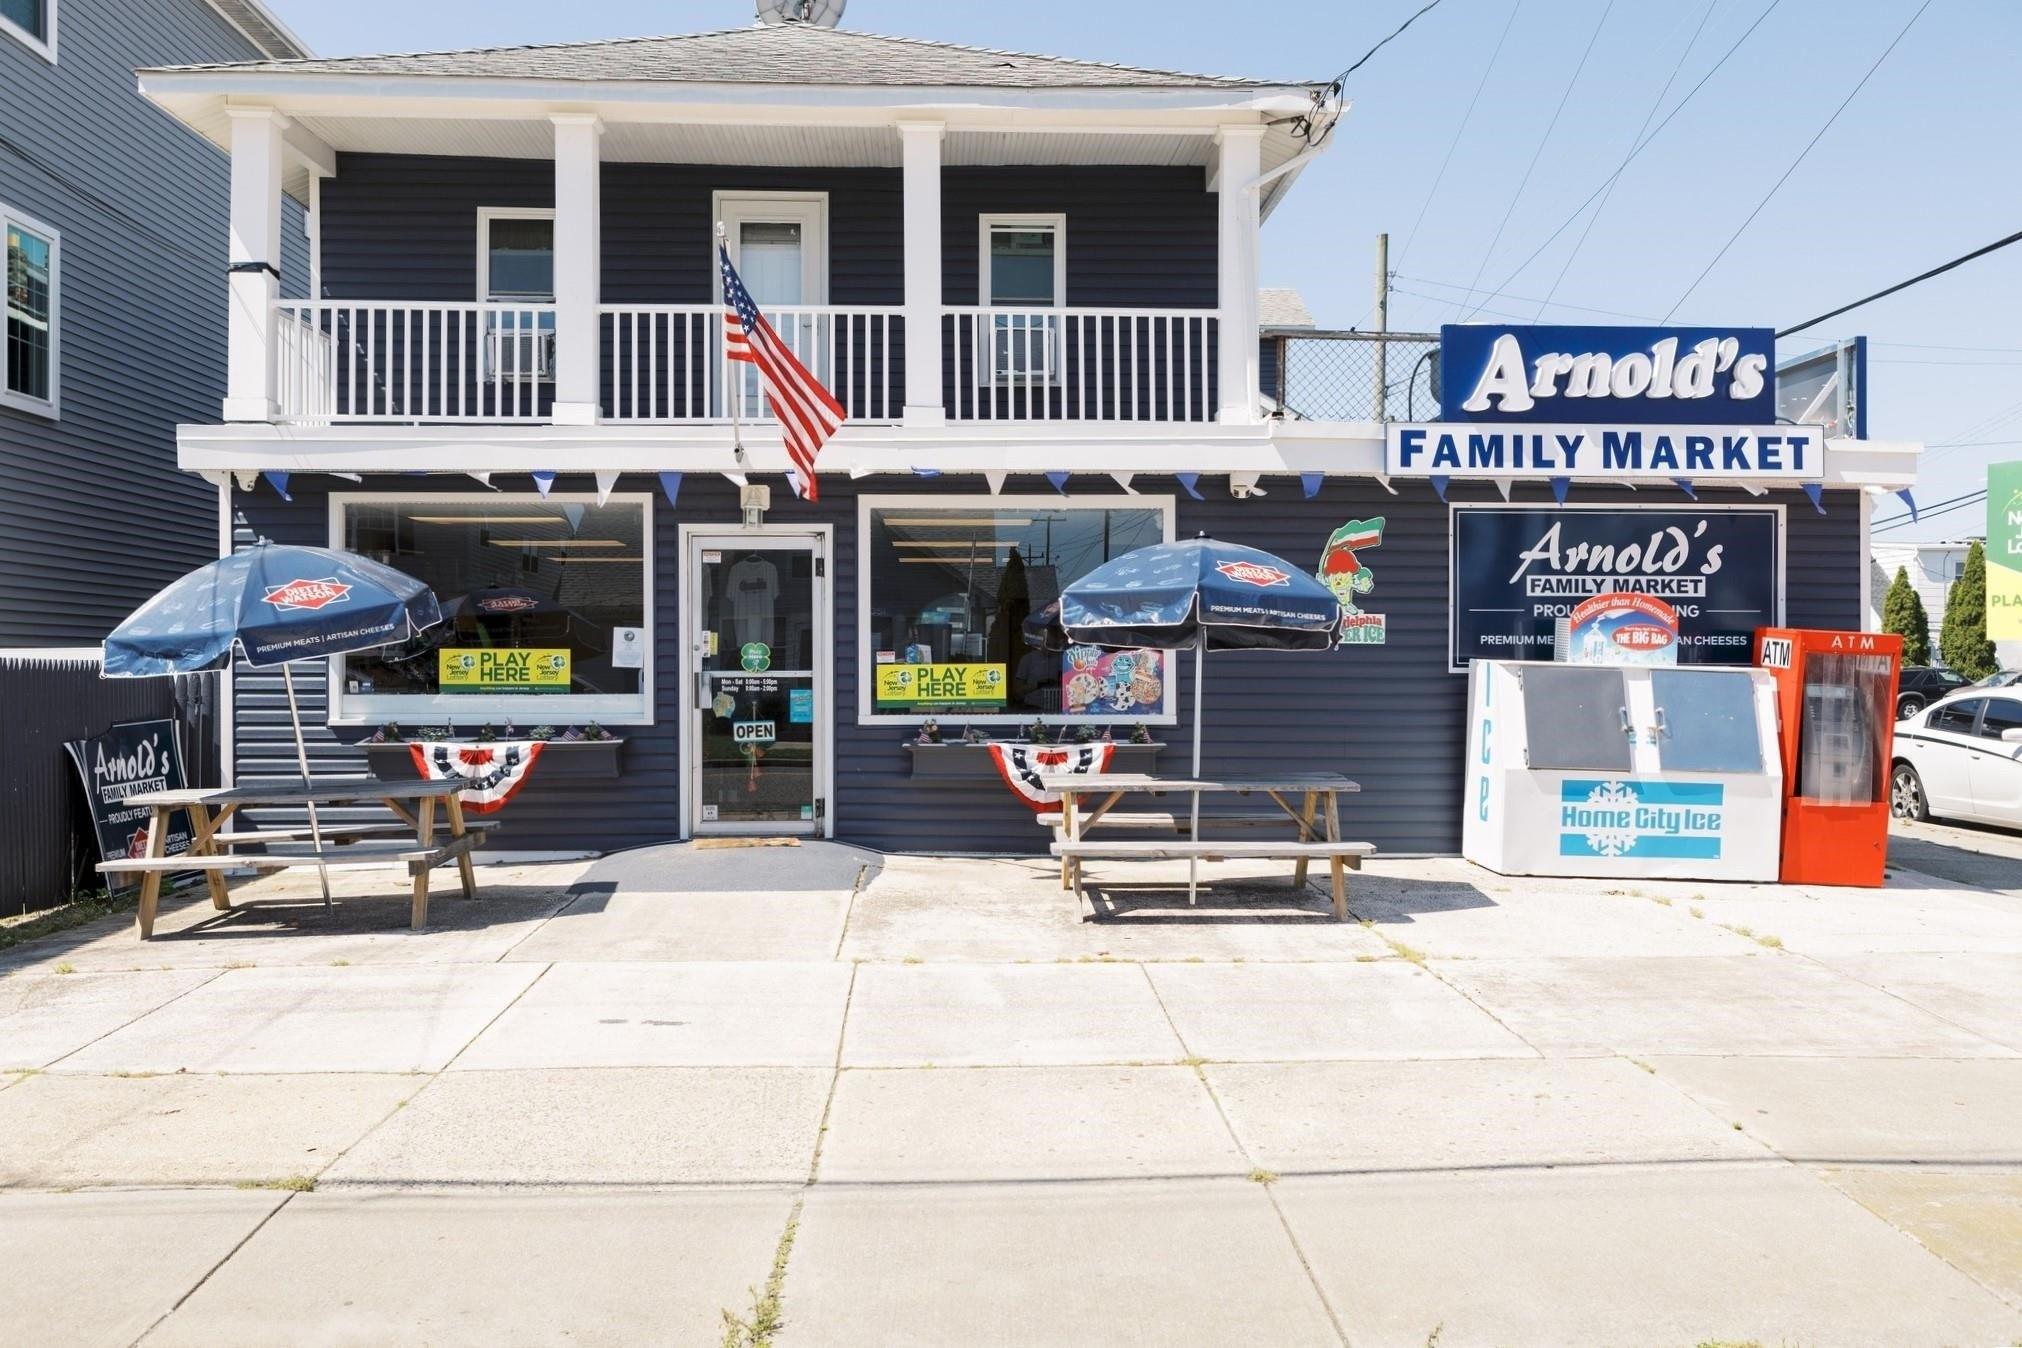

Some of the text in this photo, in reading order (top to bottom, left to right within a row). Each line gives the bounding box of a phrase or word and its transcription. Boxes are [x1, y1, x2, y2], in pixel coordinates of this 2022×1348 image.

[1462, 333, 1767, 413] Arnold's
[1400, 429, 1810, 470] FAMILY MARKET
[1509, 519, 1723, 585] Arnold's
[284, 584, 319, 596] DIETZ
[1530, 578, 1703, 595] FAMILY MARKET
[279, 588, 336, 604] WATSON
[1991, 594, 2022, 607] PLA
[1210, 605, 1326, 621] PREMIUM MEATS ARTISAN CHEESES
[1533, 604, 1574, 617] PROU
[1573, 599, 1609, 624] Healthier
[1611, 597, 1630, 607] than
[1632, 597, 1675, 625] Homemade
[1343, 615, 1382, 628] delphia
[256, 623, 395, 654] PREMIUM MEATS ARTISAN CHEESES
[1364, 625, 1384, 643] ICE
[1480, 635, 1534, 645] PREMIUM
[1694, 635, 1747, 646] CHEESES
[1615, 632, 1631, 645] THE
[1632, 631, 1650, 645] BIG
[1651, 633, 1667, 645] BAG
[1831, 635, 1874, 650] ATM
[480, 652, 531, 667] PLAY
[1762, 640, 1791, 667] ATM
[449, 669, 469, 677] Jersey
[480, 667, 530, 682] HERE
[540, 669, 559, 677] Jersey
[917, 667, 967, 682] PLAY
[917, 682, 966, 697] HERE
[736, 724, 773, 739] OPEN
[94, 733, 170, 795] Arnold's
[102, 779, 166, 802] FAMILY MARKET
[108, 805, 153, 824] PROUDLY FEATU
[1561, 806, 1721, 834] Home City Ice
